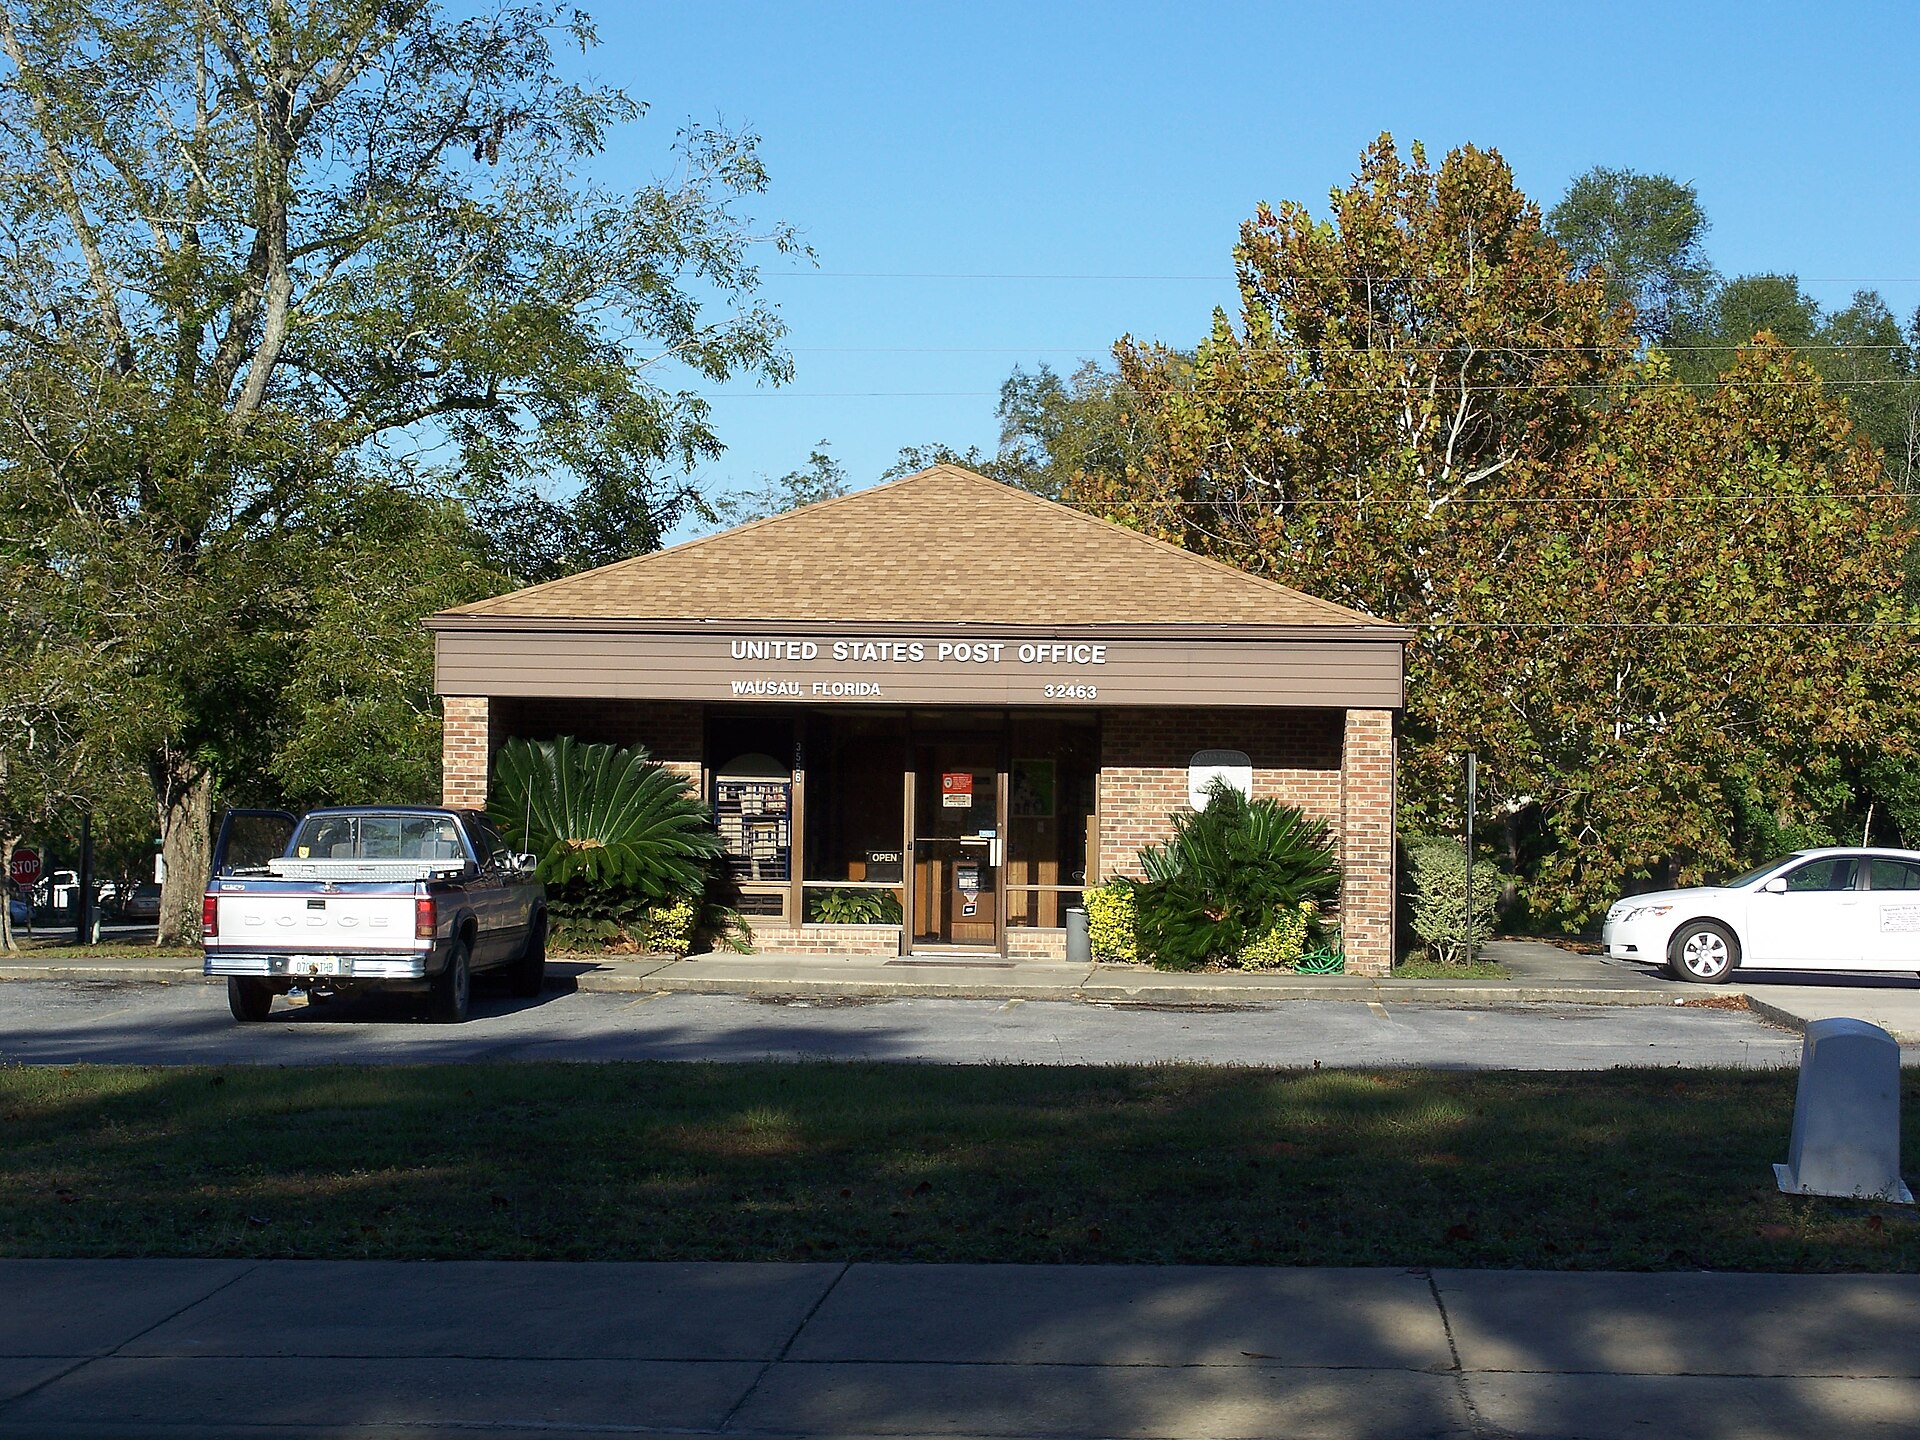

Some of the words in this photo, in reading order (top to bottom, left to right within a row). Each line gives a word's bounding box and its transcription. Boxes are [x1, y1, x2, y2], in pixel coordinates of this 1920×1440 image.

[730, 639, 818, 661] UNITED
[831, 641, 925, 663] STATES
[937, 643, 1005, 665] POST
[1018, 644, 1107, 667] OFFICE
[731, 680, 803, 697] WAUSAU,
[811, 681, 882, 699] FLORIDA
[1043, 684, 1098, 702] 32463
[872, 853, 898, 862] OPEN
[11, 859, 39, 875] STOP
[244, 915, 389, 928] DODGE
